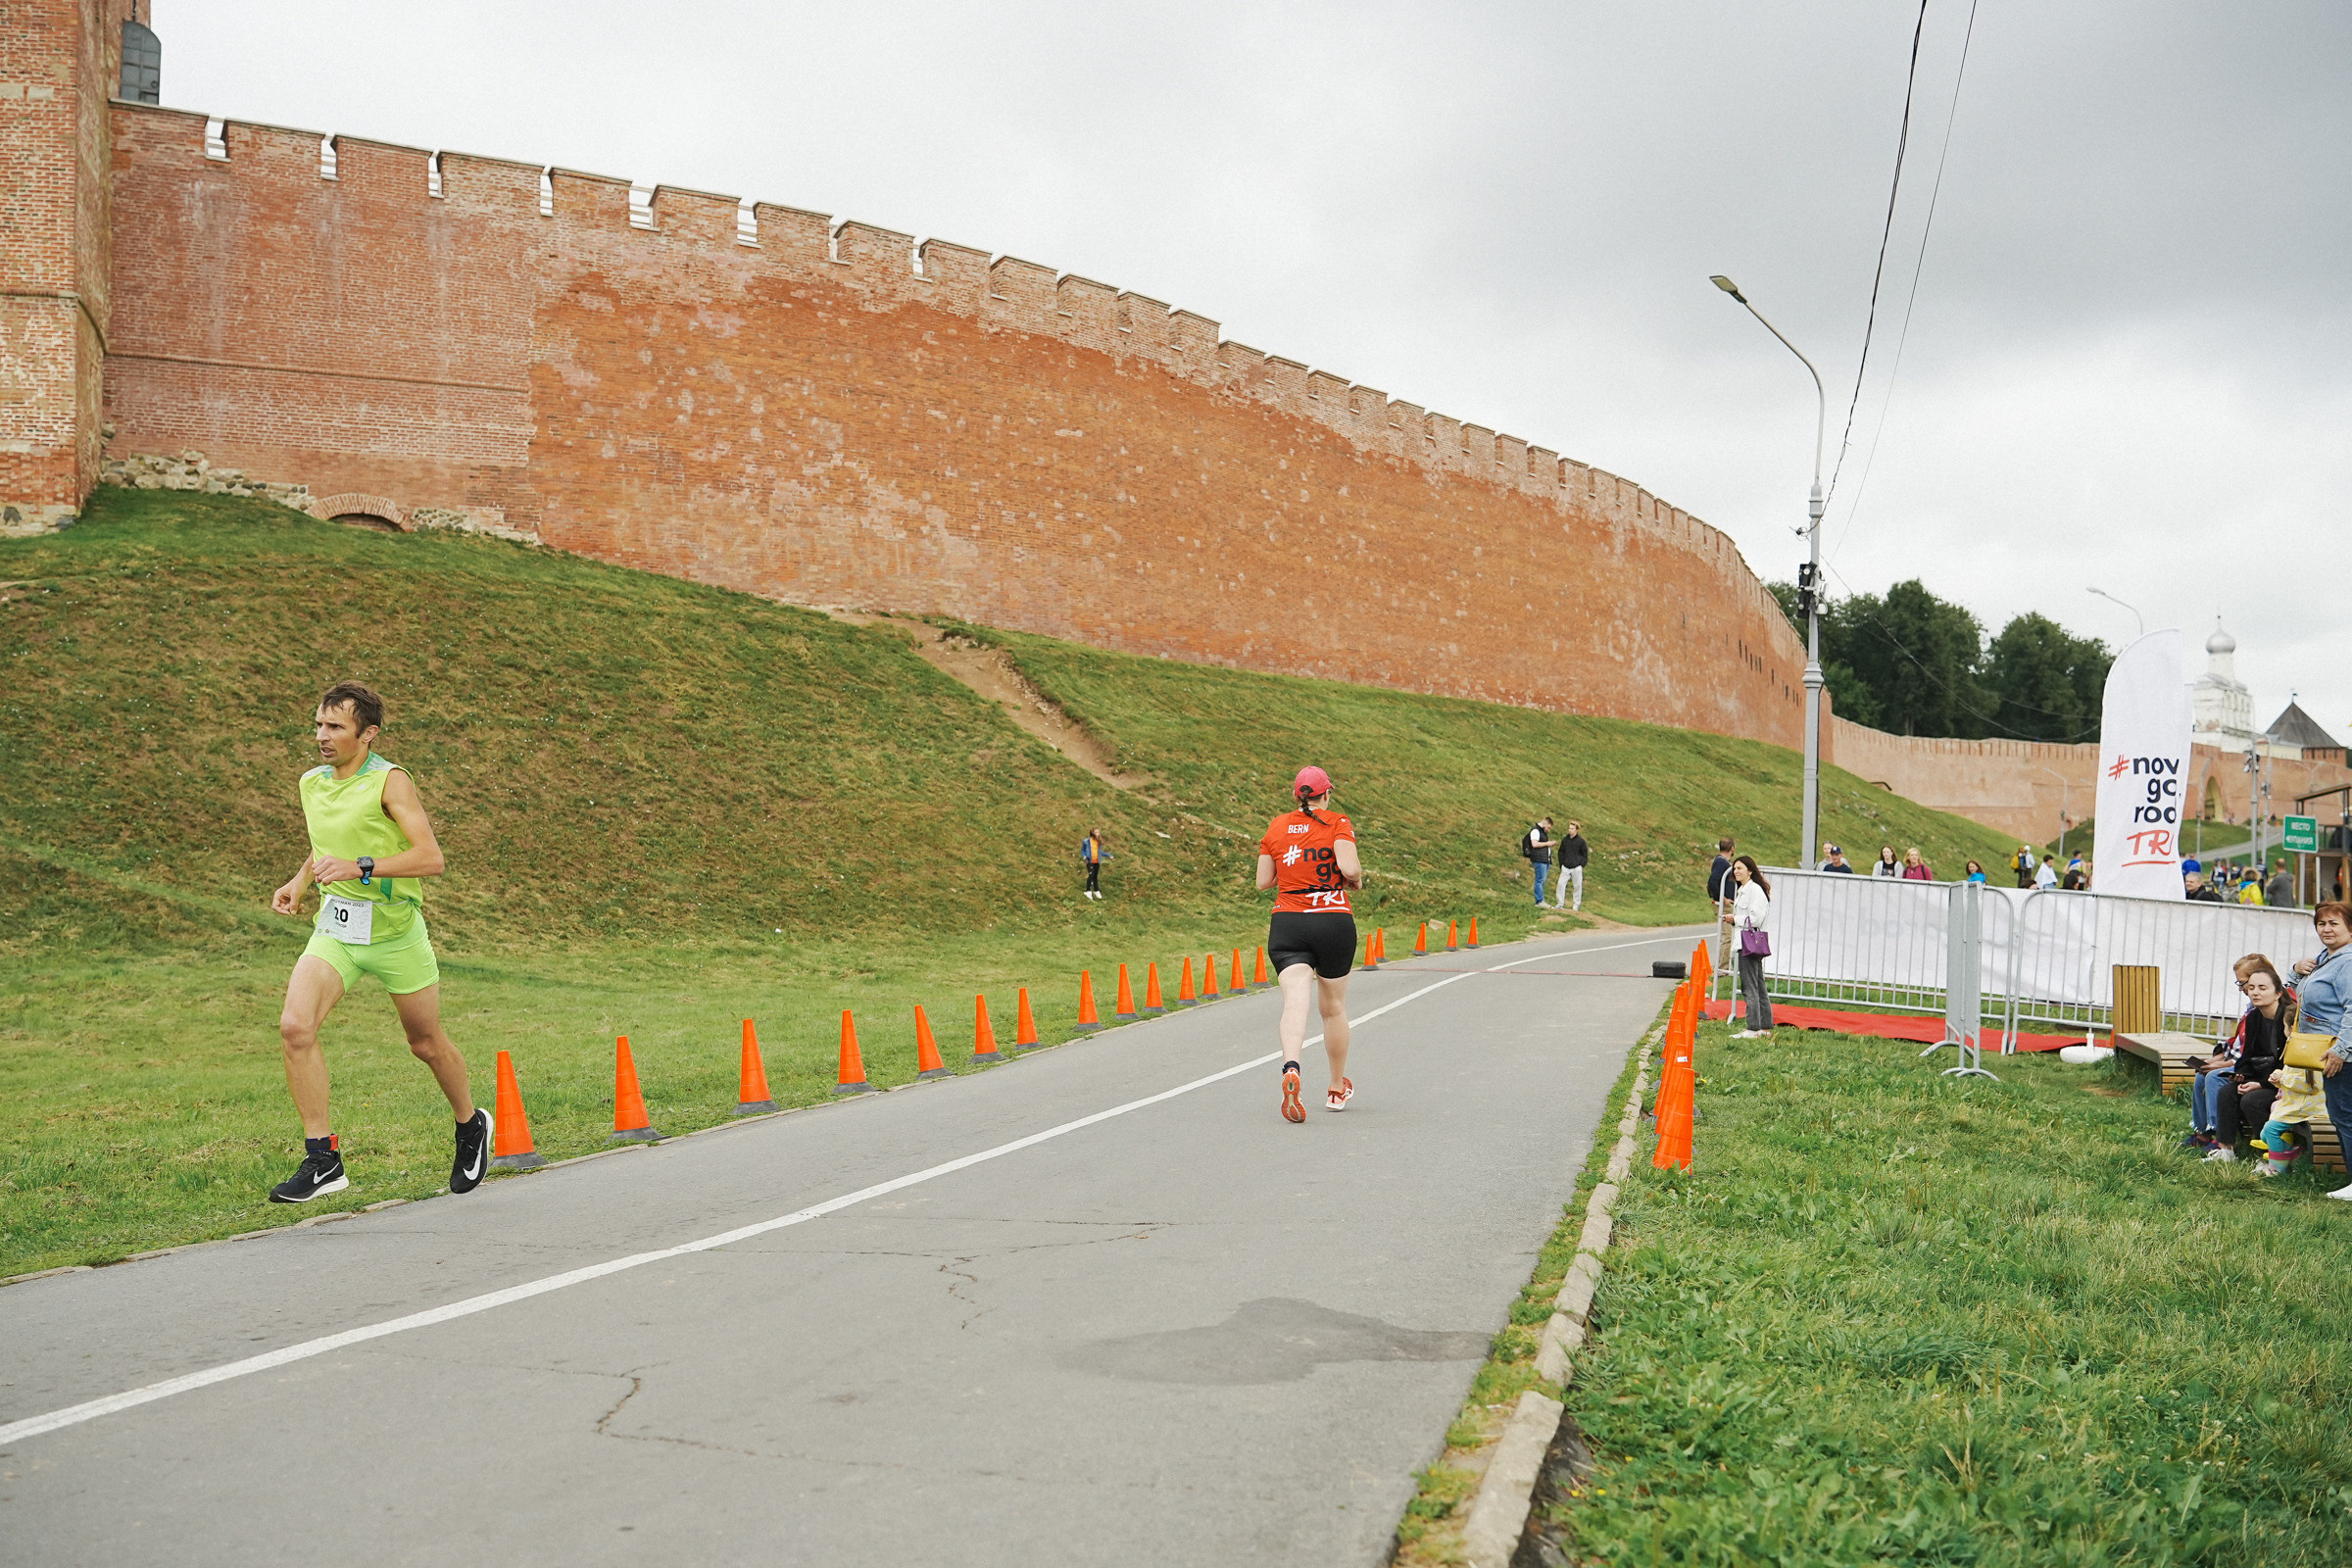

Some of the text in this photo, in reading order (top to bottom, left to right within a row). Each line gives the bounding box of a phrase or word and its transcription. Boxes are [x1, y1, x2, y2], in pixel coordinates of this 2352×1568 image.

[2108, 755, 2180, 781] #nov
[1288, 824, 1309, 834] BERN
[1282, 845, 1335, 867] #no
